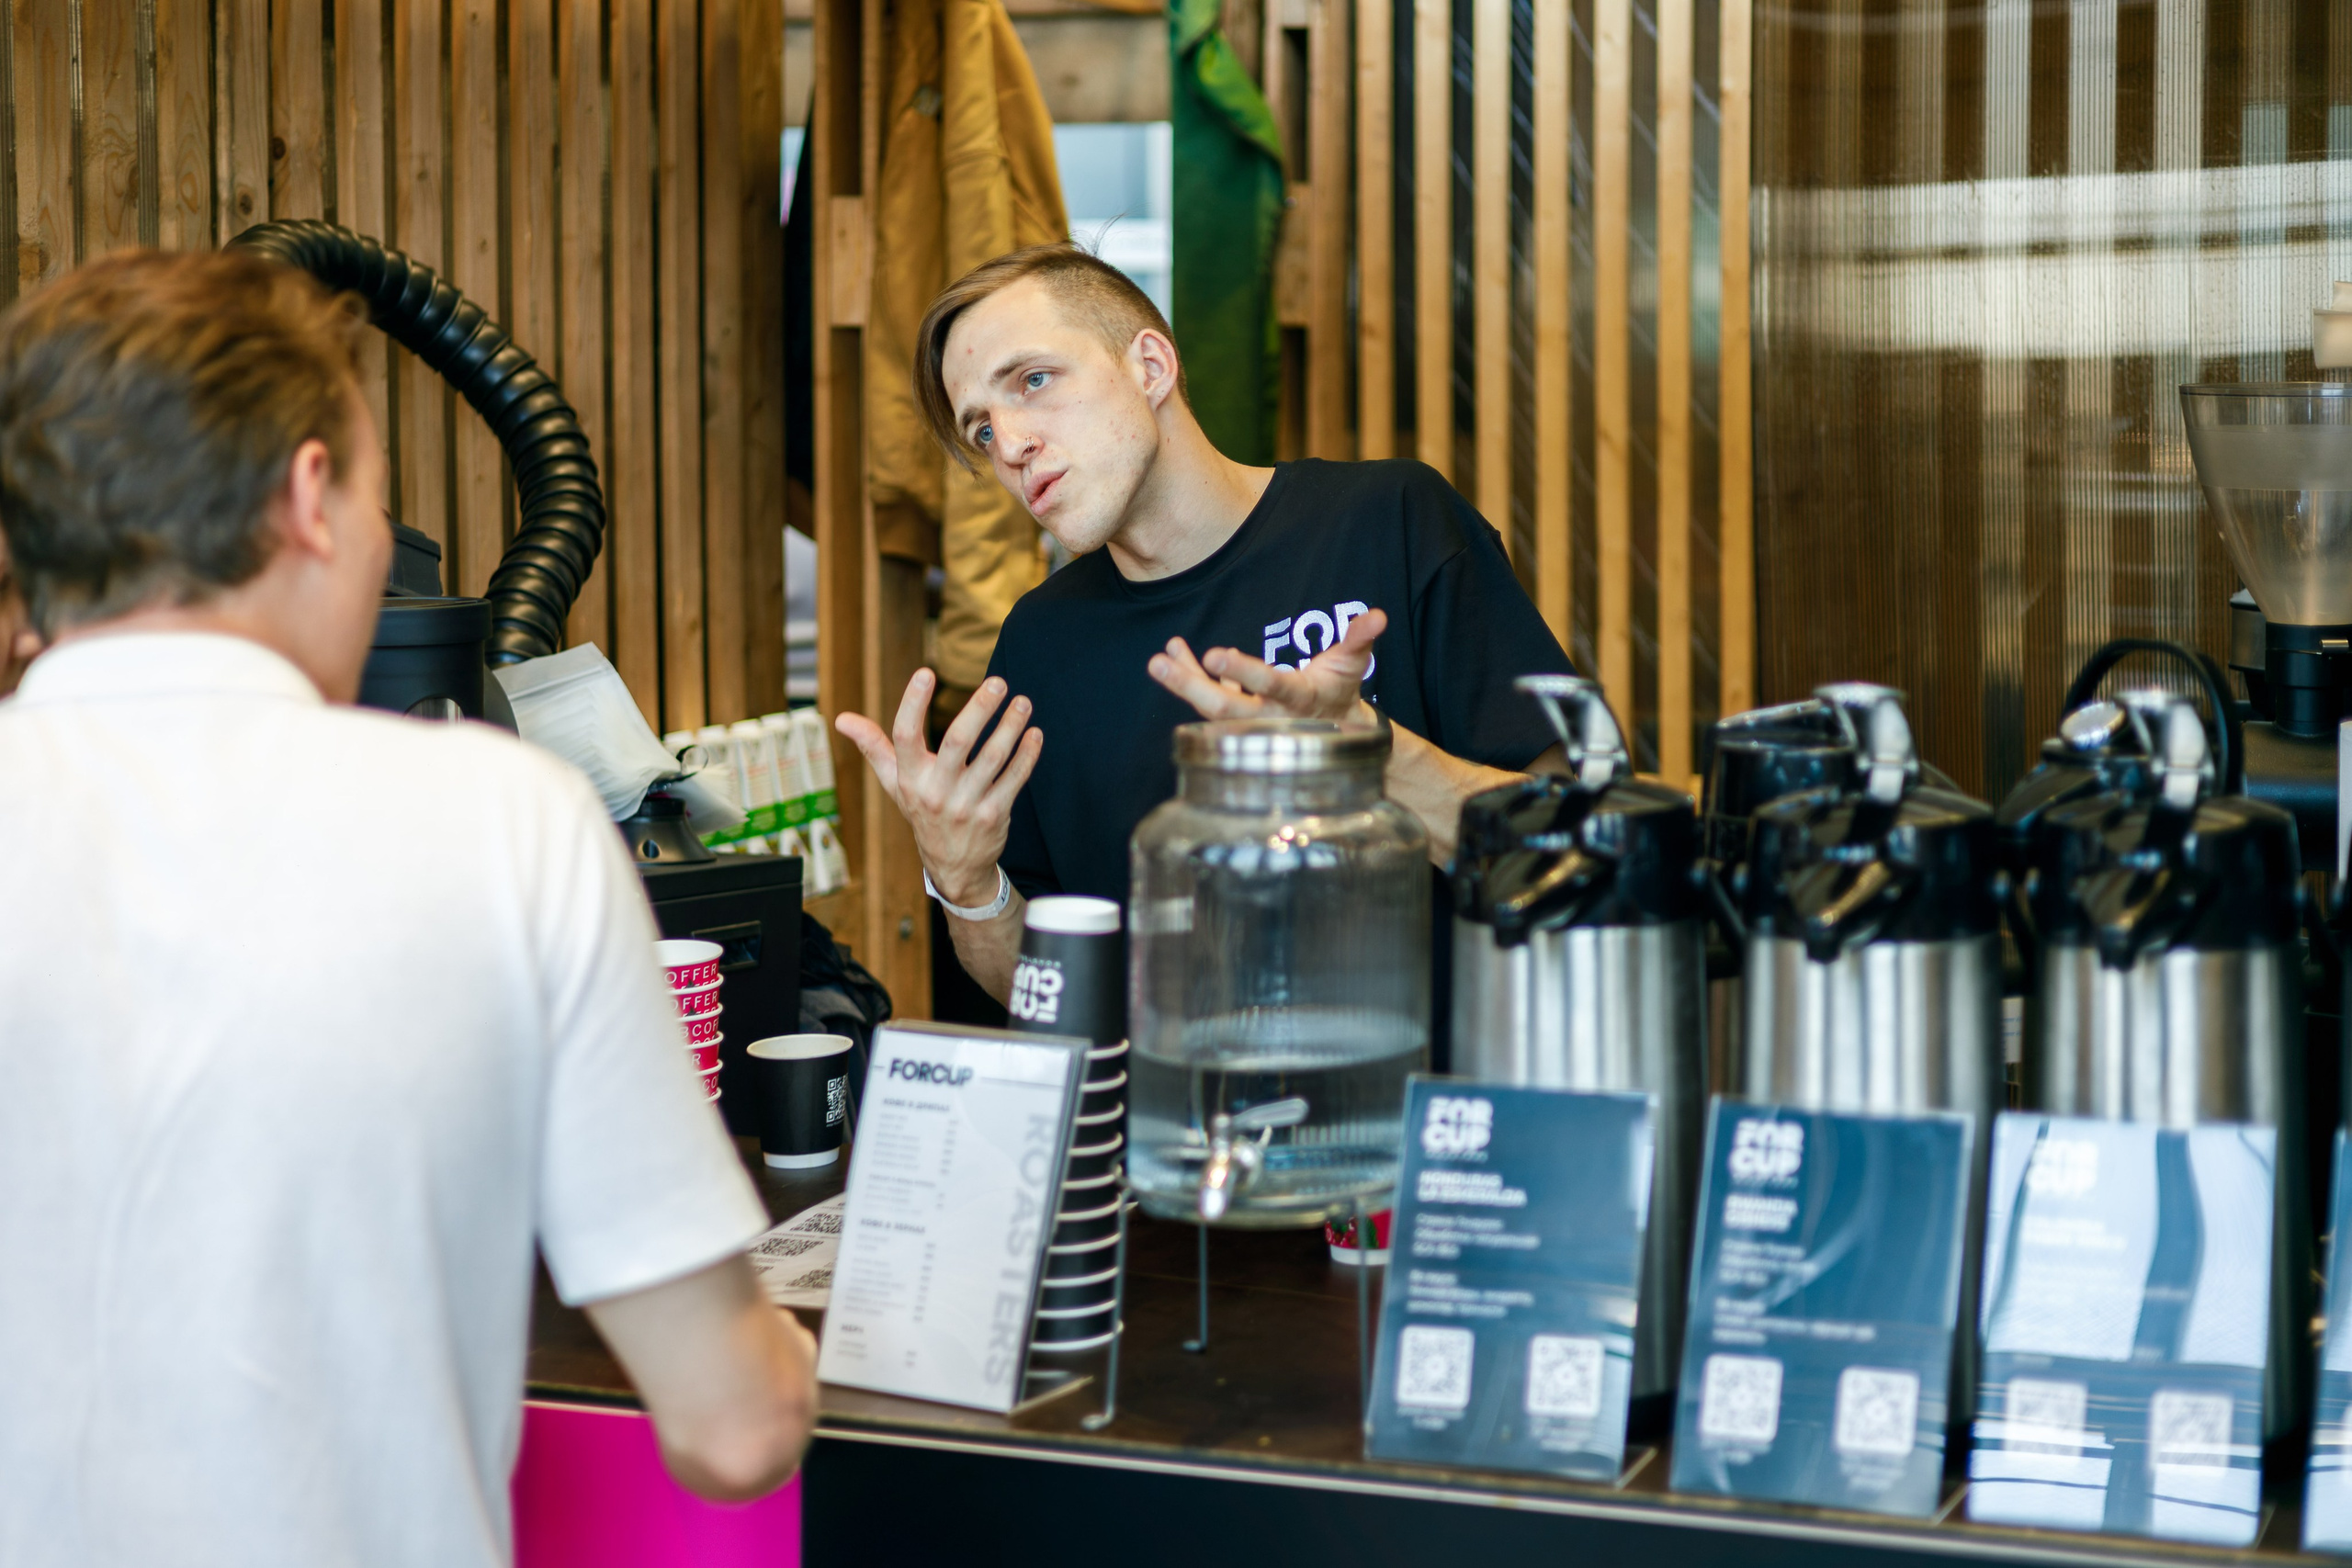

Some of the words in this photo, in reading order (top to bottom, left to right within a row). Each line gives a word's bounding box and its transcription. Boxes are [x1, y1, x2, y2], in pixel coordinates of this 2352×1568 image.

[663, 963, 717, 985] OFFER
[670, 992, 718, 1011] OFFER
[888, 1057, 974, 1086] FORCUP
[1429, 1096, 1494, 1127] FOR
[1422, 1121, 1491, 1155] CUP
[1735, 1119, 1804, 1151] FOR
[1728, 1145, 1802, 1180] CUP
